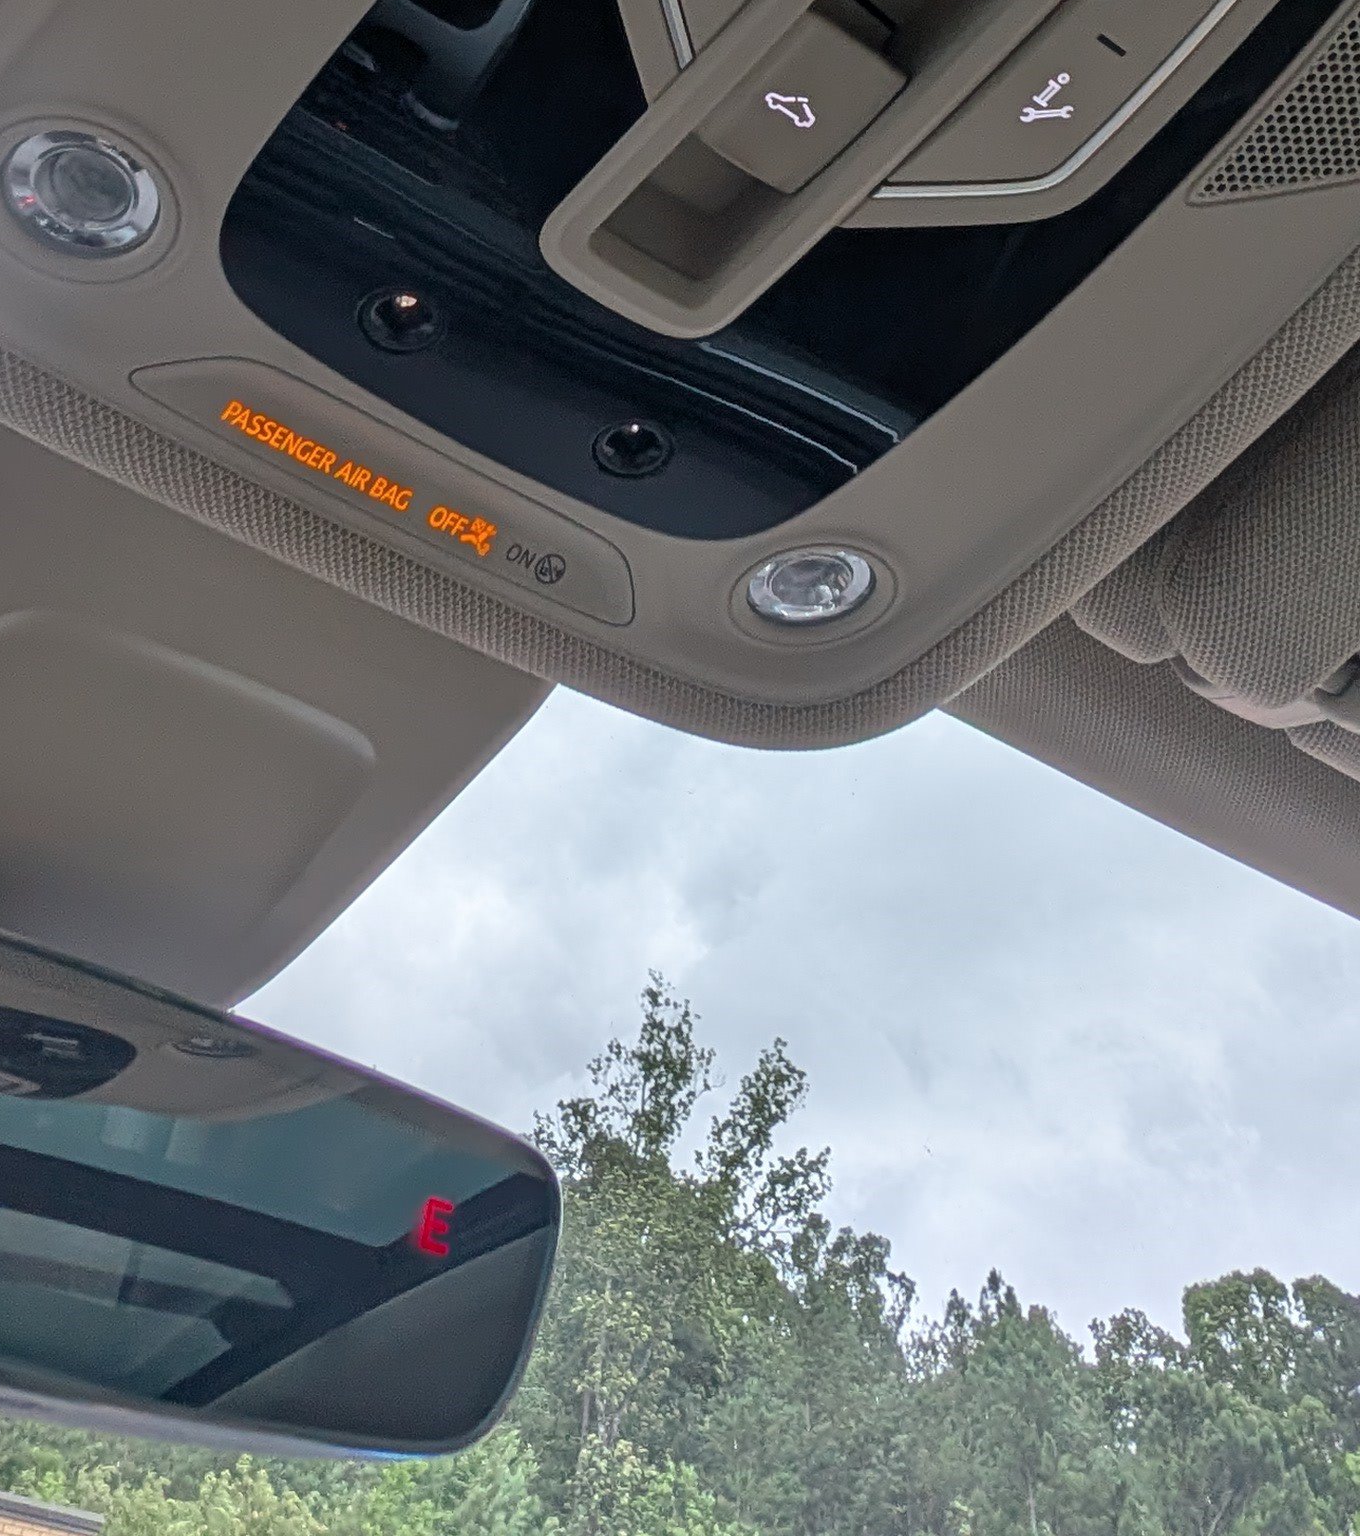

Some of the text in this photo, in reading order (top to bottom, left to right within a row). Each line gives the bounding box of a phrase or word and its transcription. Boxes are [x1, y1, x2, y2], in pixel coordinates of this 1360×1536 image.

[220, 399, 536, 570] PASSENGER AIR BAG OFF ON
[418, 1197, 453, 1255] E
